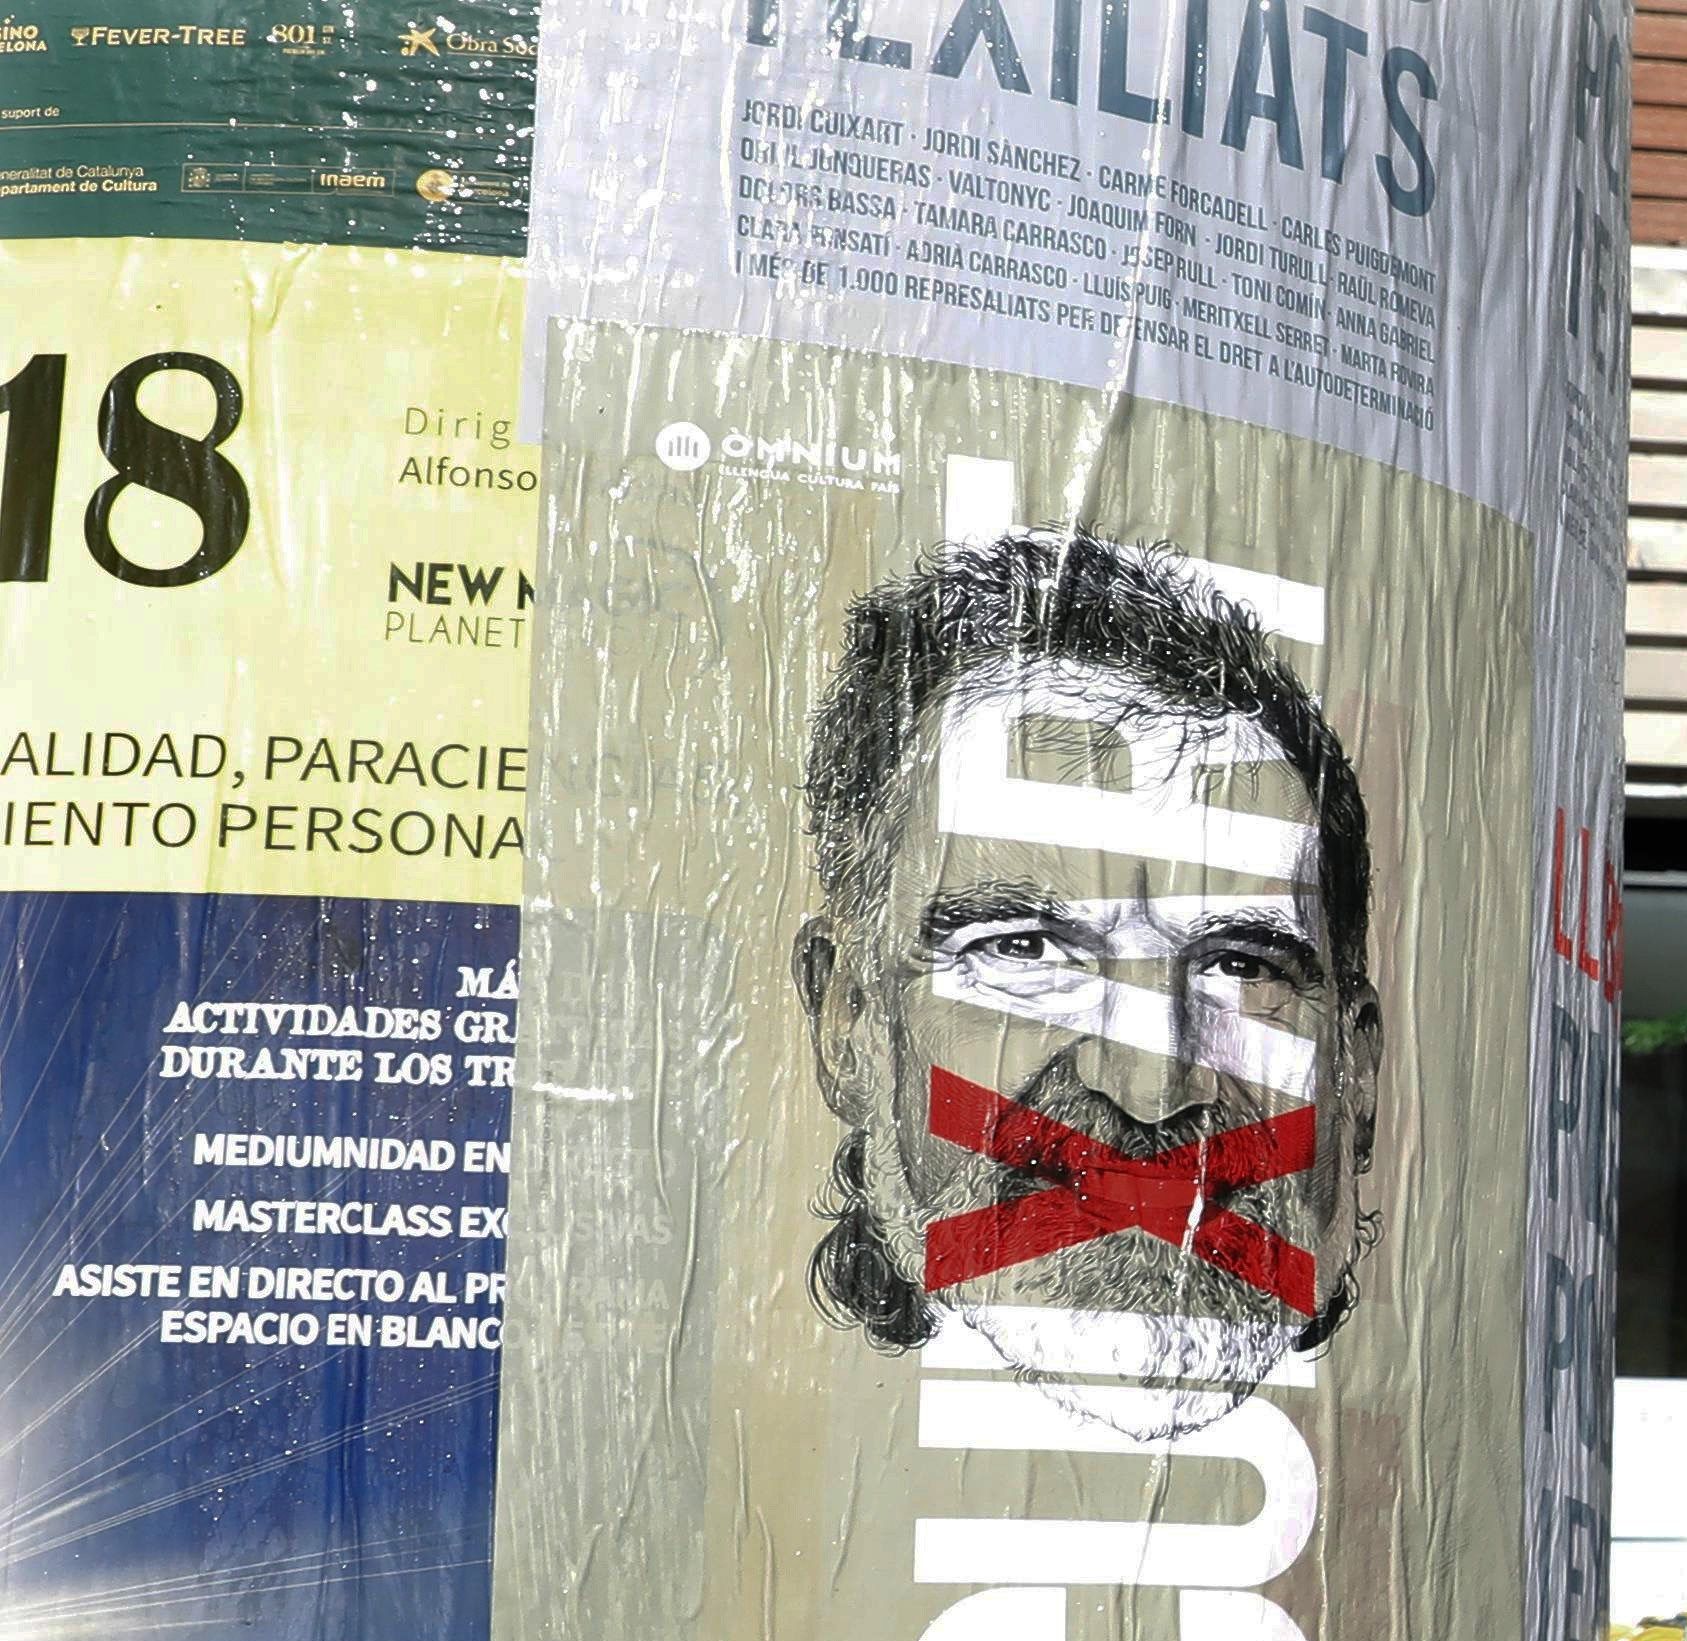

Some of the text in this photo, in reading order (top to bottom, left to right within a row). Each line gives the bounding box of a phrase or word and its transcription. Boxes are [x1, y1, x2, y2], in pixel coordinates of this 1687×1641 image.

[92, 25, 246, 46] FEVER-TREE
[271, 24, 316, 44] 801
[447, 33, 498, 54] Obra
[1, 107, 60, 119] suport de
[55, 166, 73, 178] de
[77, 165, 144, 178] Catalunya
[79, 181, 97, 193] de
[102, 179, 157, 192] Cultura
[810, 108, 904, 146] CUIXART
[922, 128, 980, 162] JORDI
[987, 137, 1082, 182] SÀNCHEZ
[1099, 165, 1167, 200] CARME
[1170, 179, 1268, 232] FORCADELL
[1281, 216, 1341, 257] CARLES
[1346, 238, 1436, 297] PUIGDEMONT
[808, 147, 932, 190] JUNQUERAS
[949, 169, 1051, 213] VALTONYC
[1066, 193, 1148, 232] JOAQUIM
[1155, 211, 1197, 248] FORN
[1215, 232, 1264, 267] JORDI
[1268, 246, 1328, 288] TURULL
[1337, 270, 1377, 307] RAÜL
[1379, 287, 1436, 331] ROMEVA
[828, 187, 896, 220] BASSA
[914, 201, 998, 241] TAMARA
[1002, 218, 1107, 262] CARRASCO
[1176, 254, 1217, 291] RULL
[1231, 271, 1272, 304] TONI
[1275, 290, 1326, 322] COMÍN
[1336, 306, 1378, 339] ANNA
[1380, 319, 1437, 364] GABRIEL
[838, 265, 899, 297] 1.000
[904, 274, 1050, 324] REPRESALIATS
[1194, 333, 1214, 360] EL
[1219, 341, 1264, 373] DRET
[1268, 354, 1281, 378] A
[905, 239, 965, 270] ADRIÀ
[968, 250, 1067, 290] CARRASCO
[1083, 271, 1131, 303] LLUÍS
[1136, 280, 1173, 312] PUIG
[1182, 295, 1273, 341] MERITXELL
[1275, 319, 1330, 358] SERRET
[1340, 343, 1389, 379] MARTA
[1390, 361, 1434, 398] ROVIRA
[404, 407, 511, 450] Dirig
[722, 427, 900, 475] ÒMNIUM
[398, 456, 538, 491] Alfonso
[798, 473, 864, 490] CULTURA
[388, 561, 504, 606] NEW
[385, 611, 526, 648] PLANET
[0, 731, 245, 789] ALIDAD,
[264, 735, 528, 793] PARACIE
[4, 801, 526, 859] IENTO PERSONA
[456, 959, 519, 1000] MÁ
[163, 1001, 515, 1045] ACTIVIDADES GR
[160, 1046, 363, 1081] DURANTE
[375, 1052, 453, 1086] LOS
[193, 1132, 510, 1173] MEDIUMNIDAD EN
[193, 1199, 452, 1237] MASTERCLASS
[52, 1264, 182, 1298] ASISTE
[188, 1266, 240, 1299] EN
[248, 1266, 404, 1302] DIRECTO
[408, 1271, 457, 1304] AL
[160, 1310, 504, 1350] ESPACIO EN BLANC
